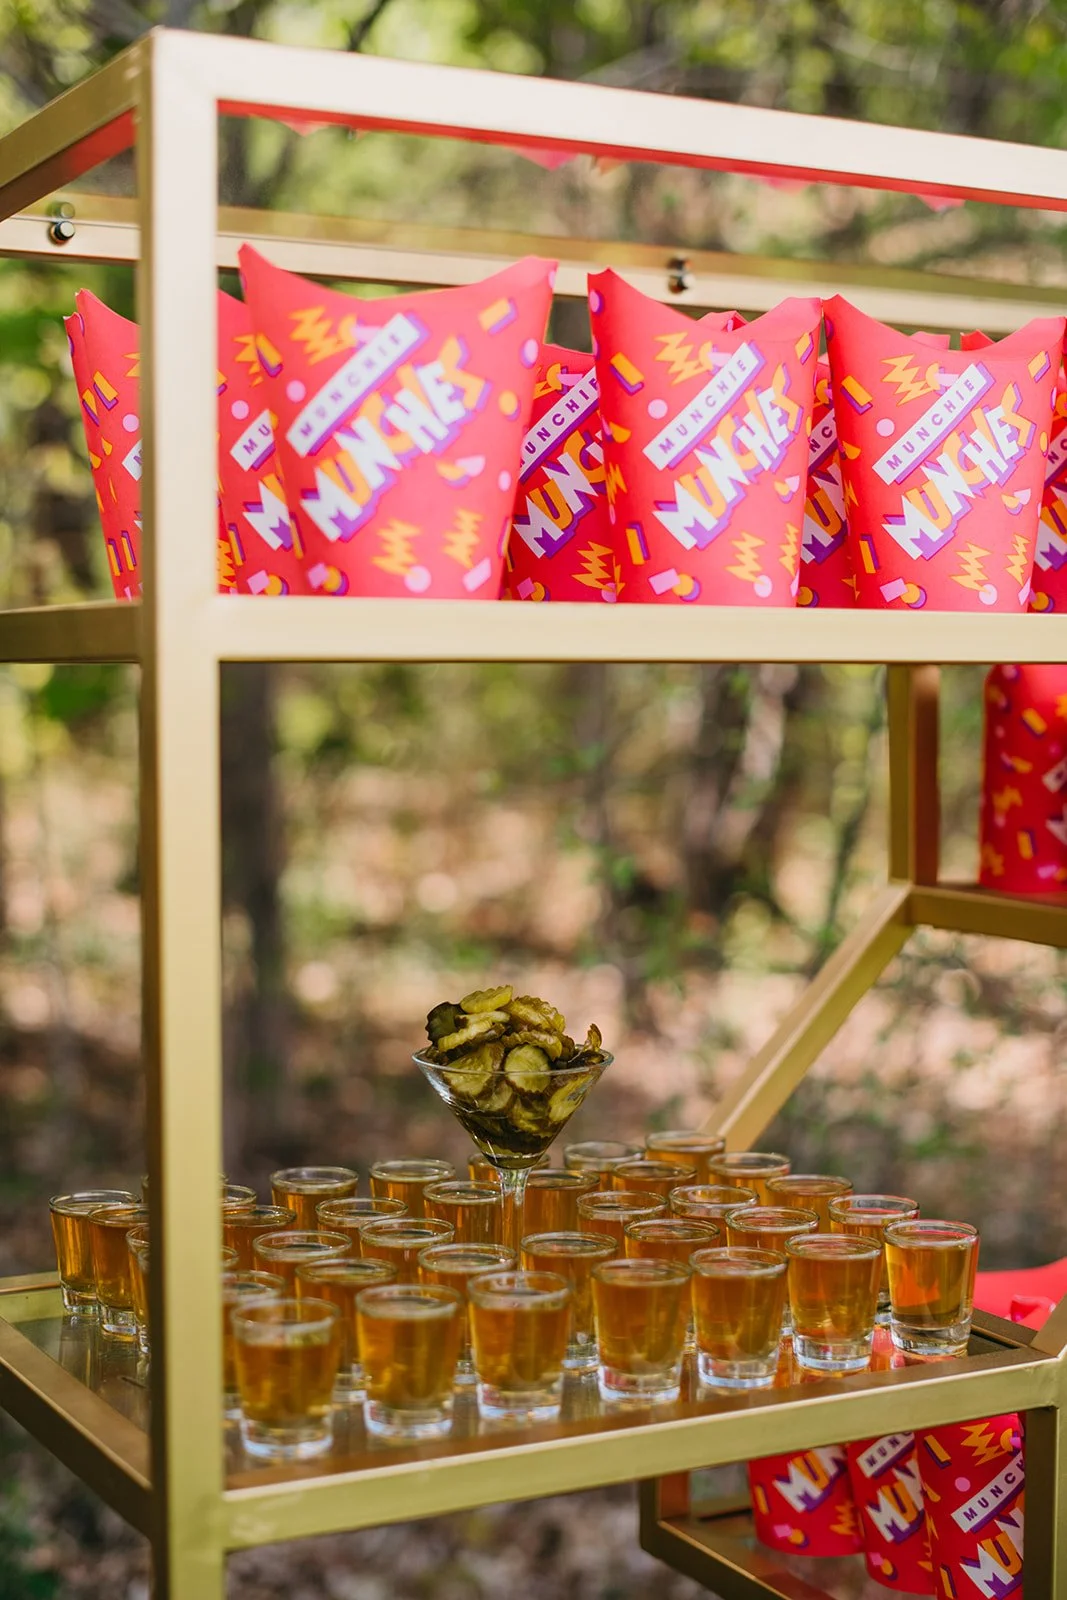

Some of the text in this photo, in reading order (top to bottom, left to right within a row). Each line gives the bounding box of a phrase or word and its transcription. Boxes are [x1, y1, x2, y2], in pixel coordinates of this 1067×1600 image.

[299, 334, 401, 437] MUNCHIE
[659, 359, 748, 454] MUNCHIE
[886, 379, 975, 470] MUNCHIE
